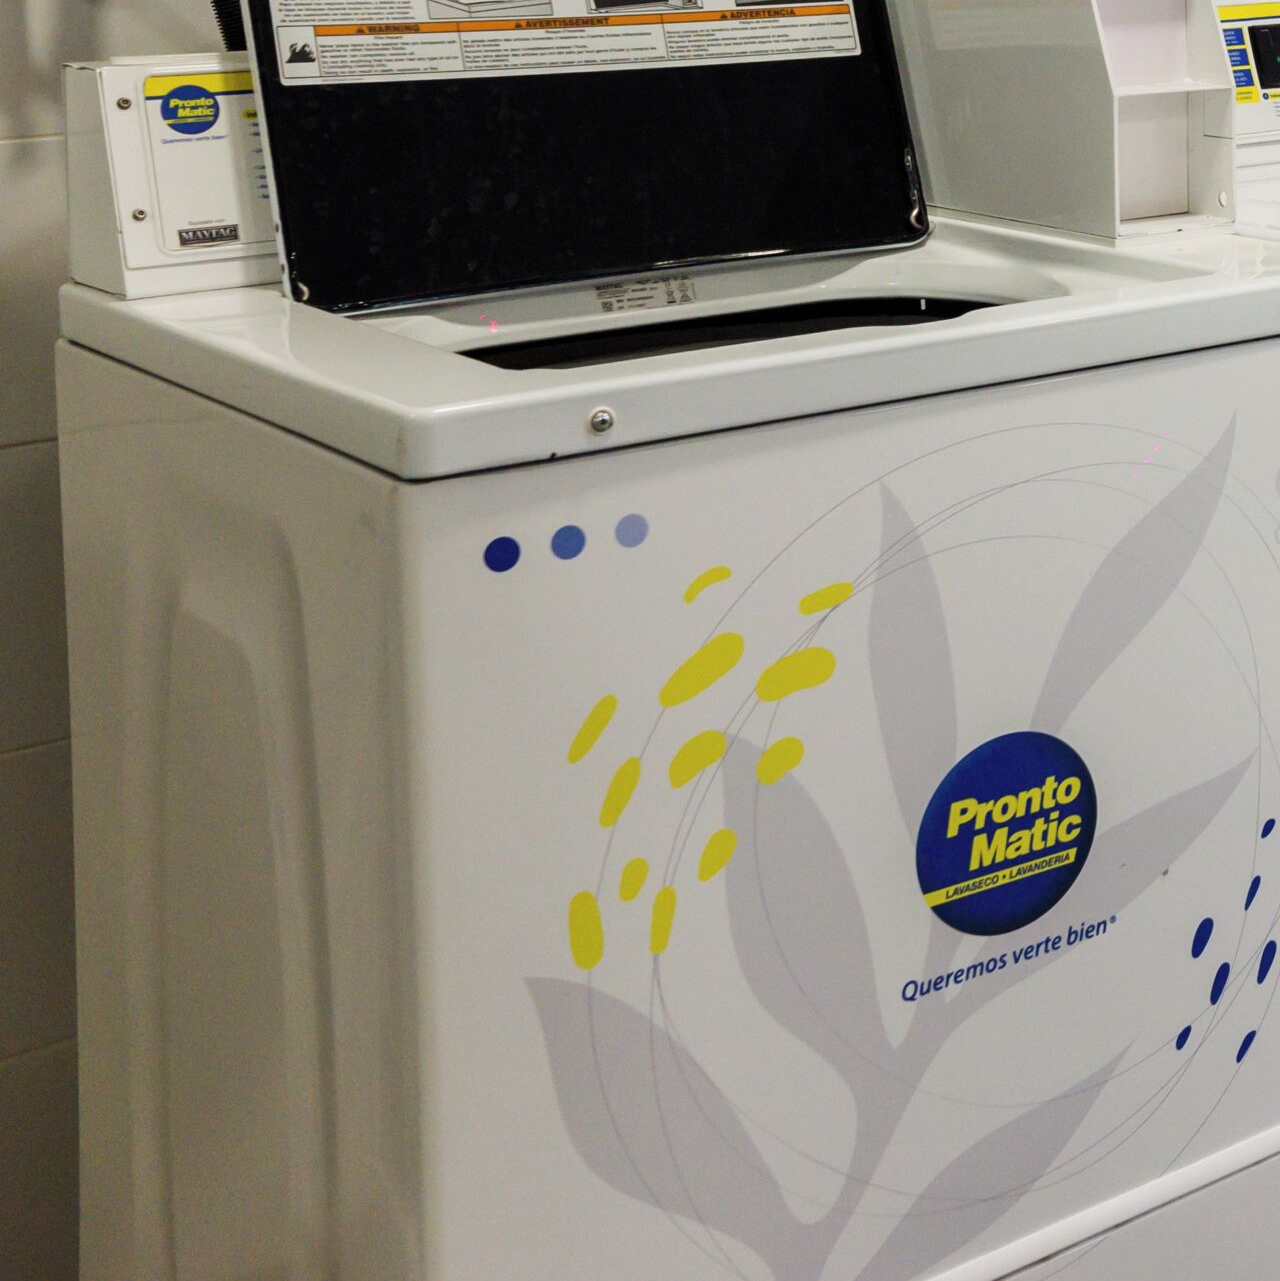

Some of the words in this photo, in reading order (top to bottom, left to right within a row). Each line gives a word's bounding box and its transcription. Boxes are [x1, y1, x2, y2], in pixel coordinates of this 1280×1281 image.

[367, 24, 420, 34] WARNING
[169, 98, 214, 109] Pronto
[177, 107, 215, 118] Matic
[182, 226, 236, 242] MAYTAG
[946, 775, 1081, 838] Pronto
[969, 810, 1082, 871] Matic
[945, 875, 999, 900] LAVASECO
[1009, 853, 1071, 880] LAVANDERIA
[902, 952, 1007, 1002] Queremos
[1012, 933, 1062, 965] verte
